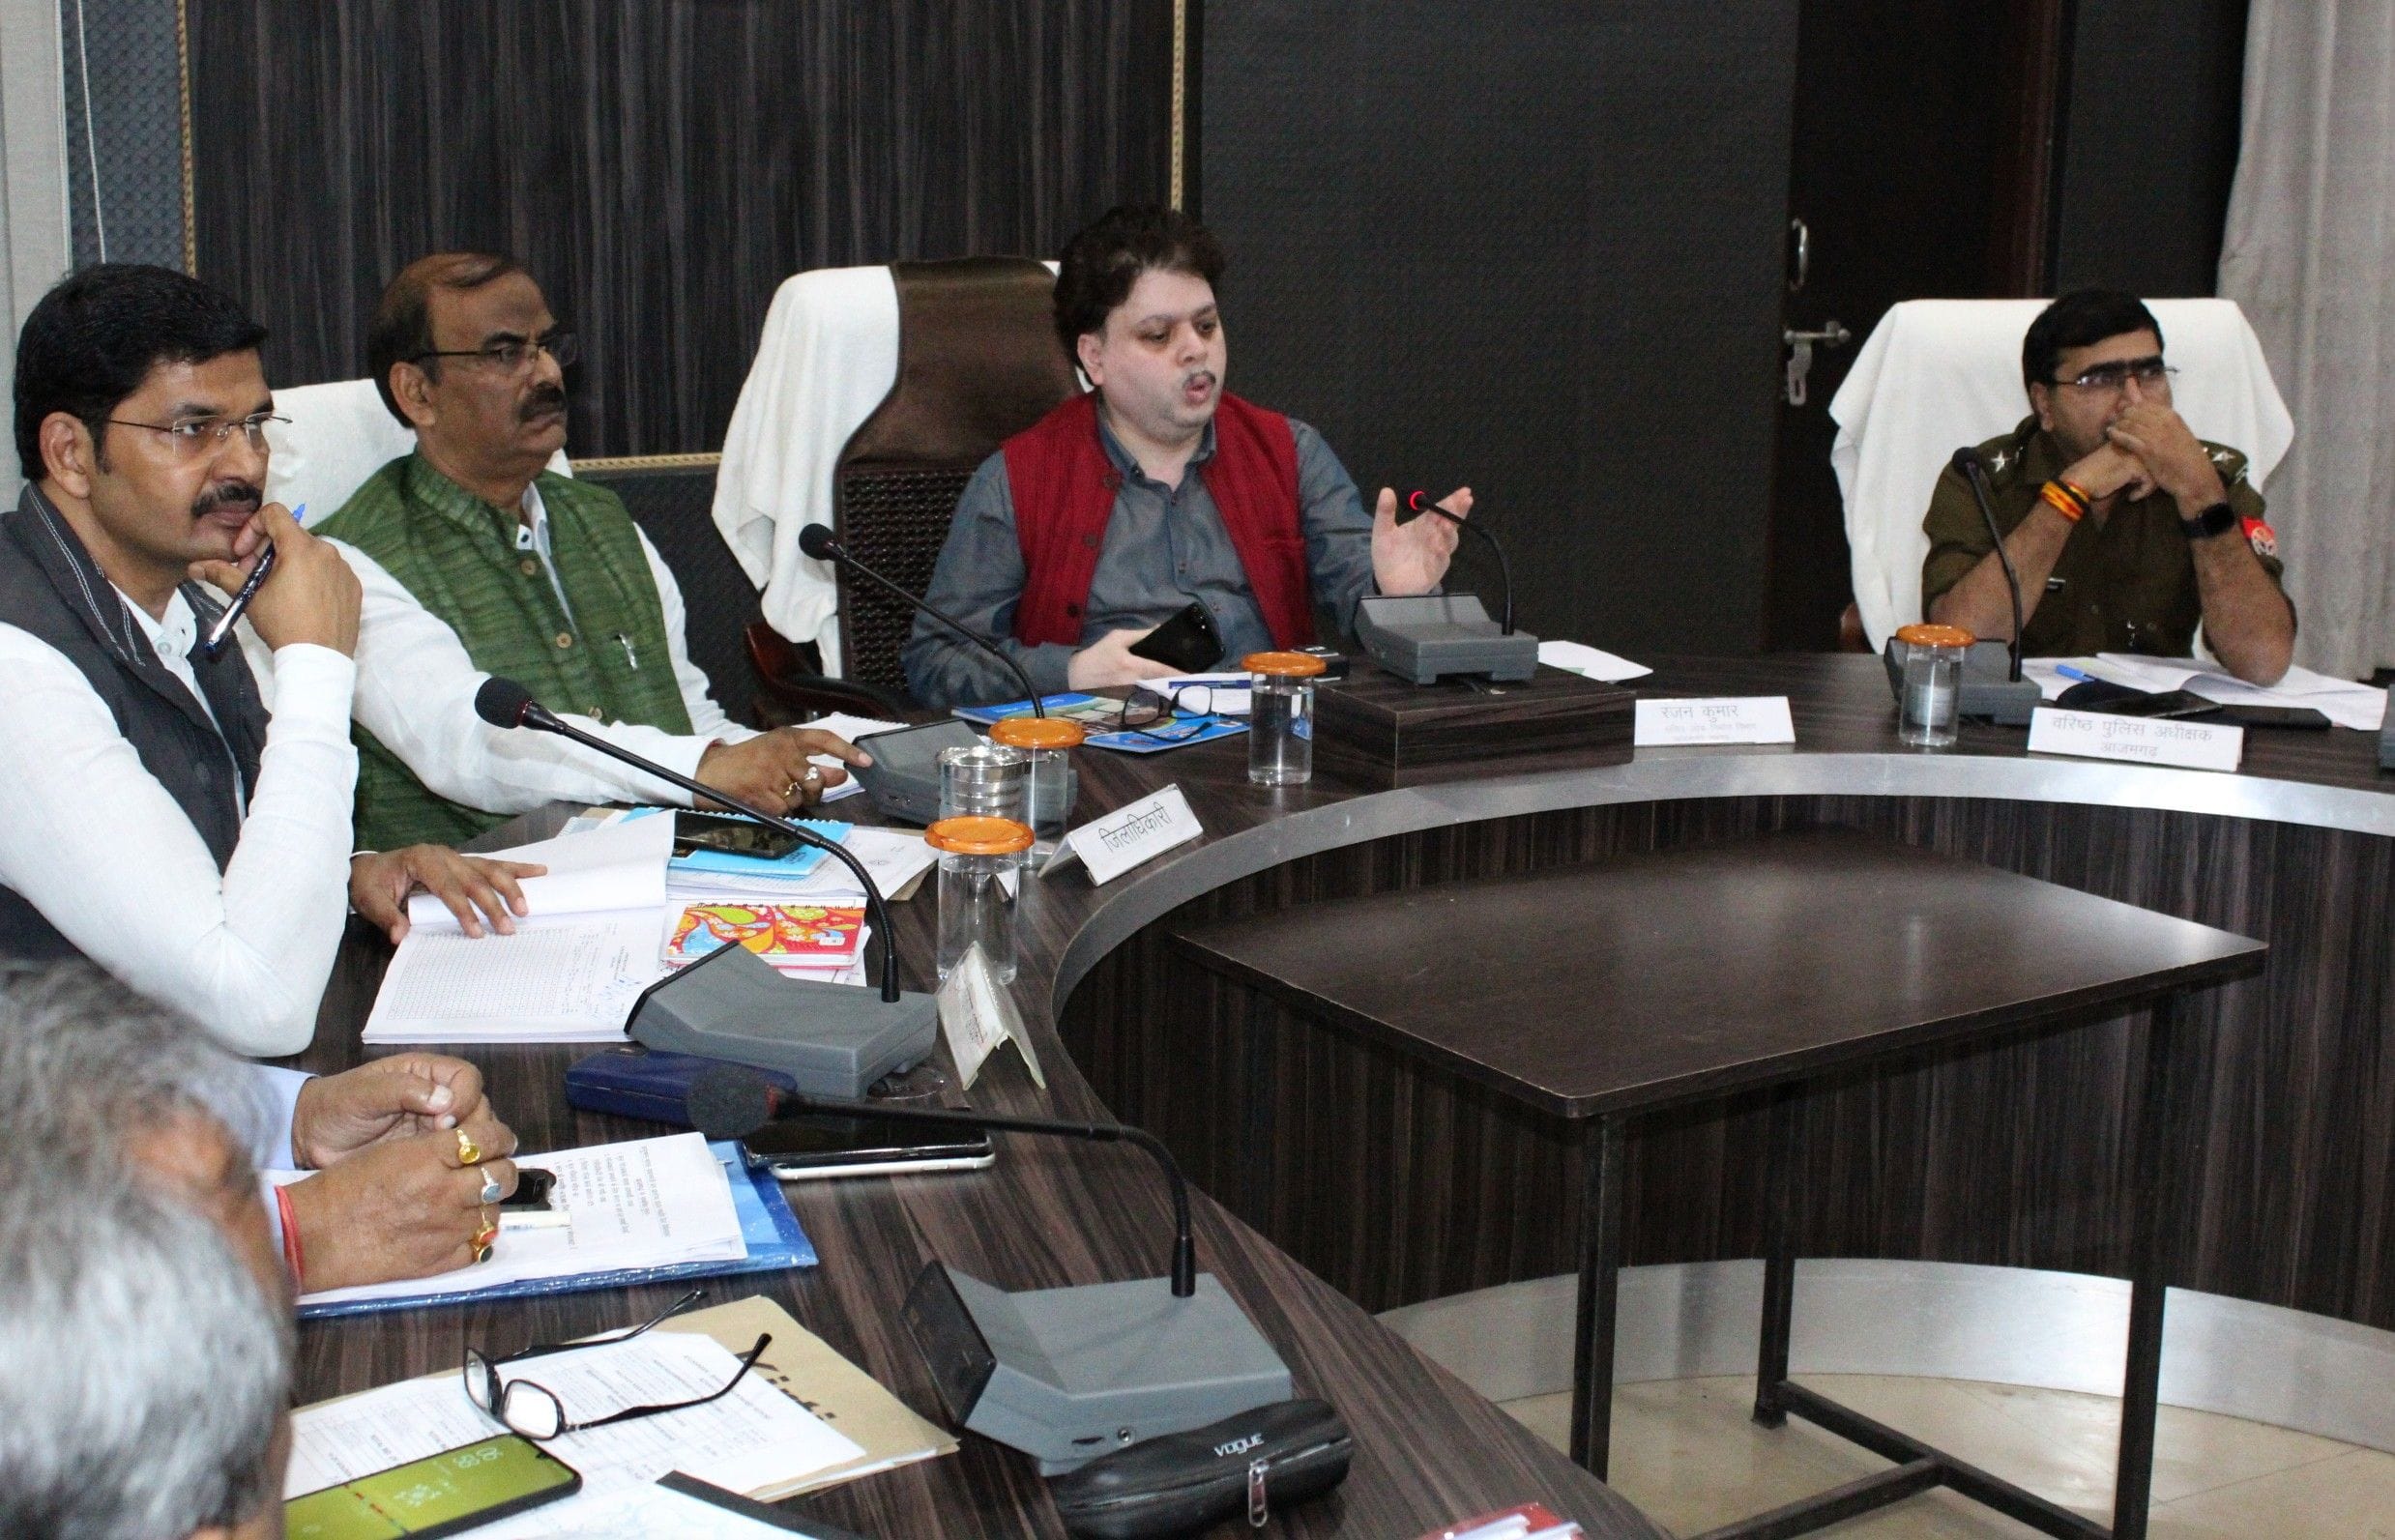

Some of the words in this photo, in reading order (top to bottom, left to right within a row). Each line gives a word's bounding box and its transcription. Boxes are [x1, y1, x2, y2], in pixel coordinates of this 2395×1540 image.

[1702, 704, 1739, 724] कुमार
[2052, 714, 2093, 732] वरिष्ठ
[2102, 718, 2146, 738] पुलिस
[2154, 724, 2213, 741] अधीक्षक
[1099, 801, 1172, 853] जिलाधिकारी
